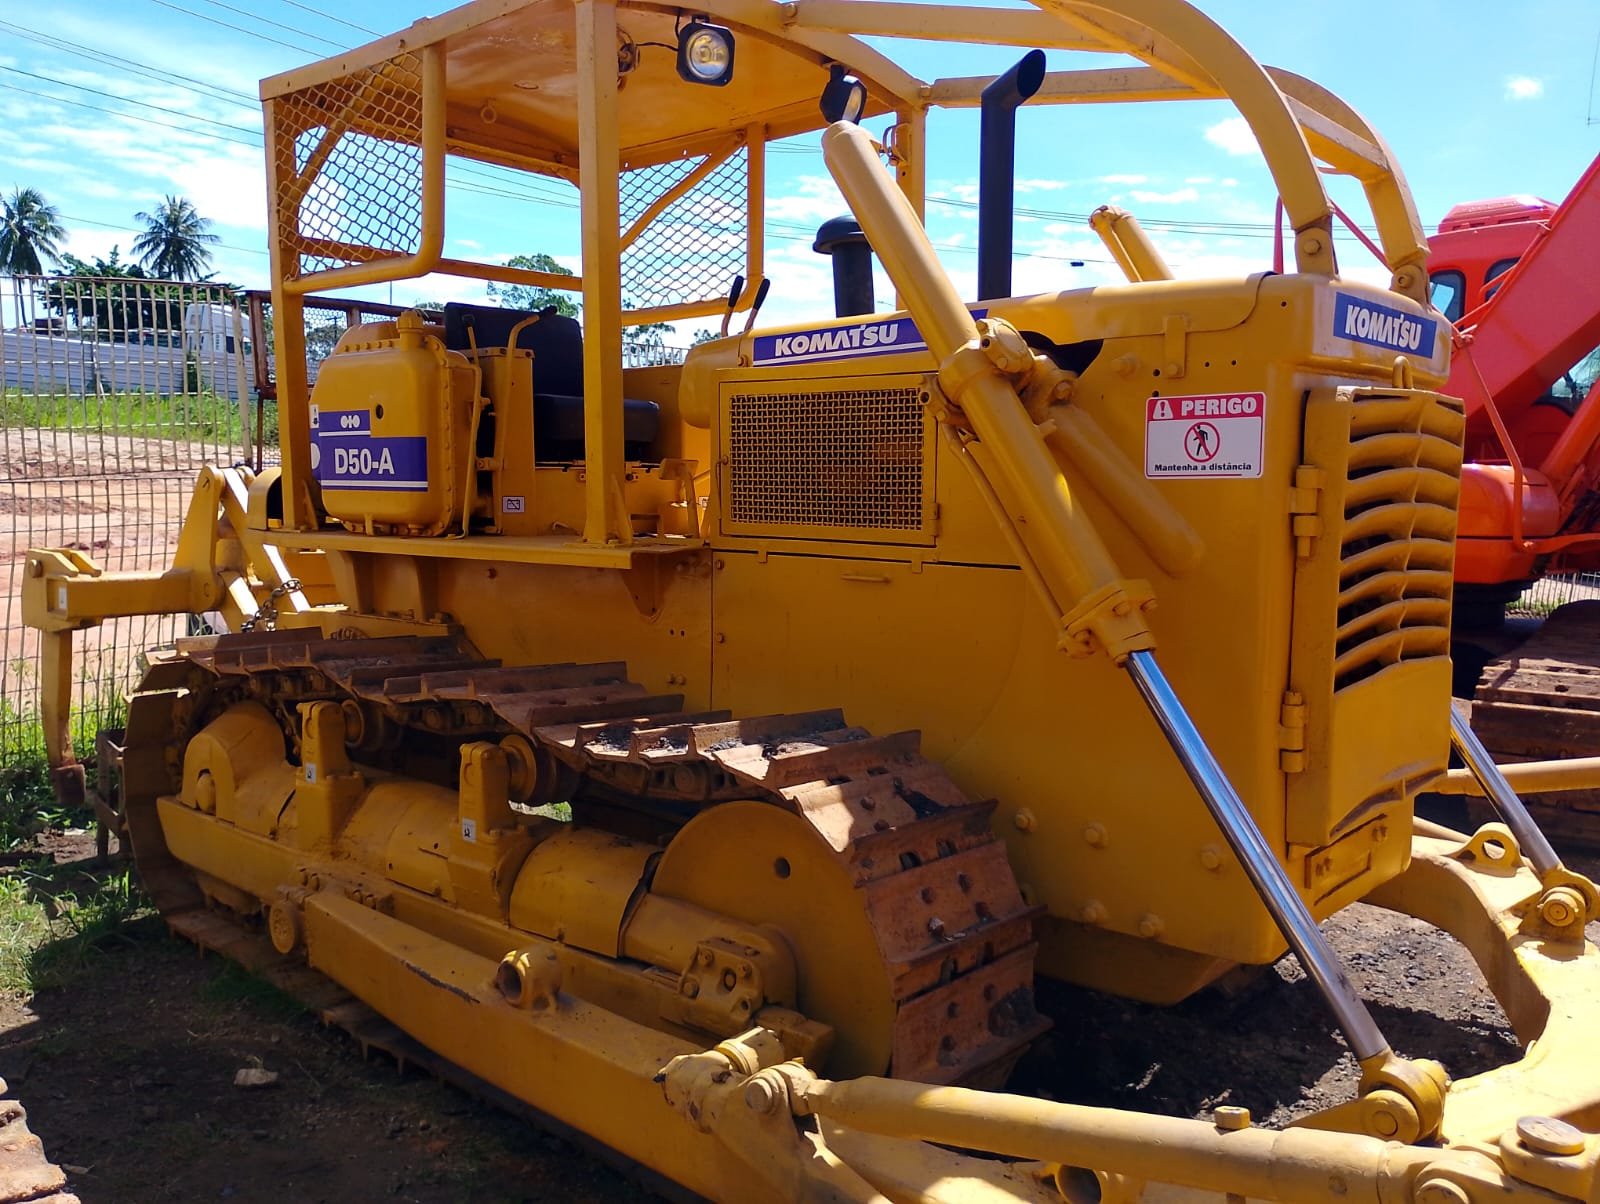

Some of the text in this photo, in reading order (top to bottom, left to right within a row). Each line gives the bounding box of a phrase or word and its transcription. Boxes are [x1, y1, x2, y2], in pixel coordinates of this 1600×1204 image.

[775, 323, 898, 357] KOMATSU
[1345, 304, 1422, 350] KOMATSU
[1181, 397, 1257, 416] PERIGO
[334, 448, 395, 474] D50-A
[1154, 463, 1198, 472] Mantenha
[1209, 462, 1252, 471] distância
